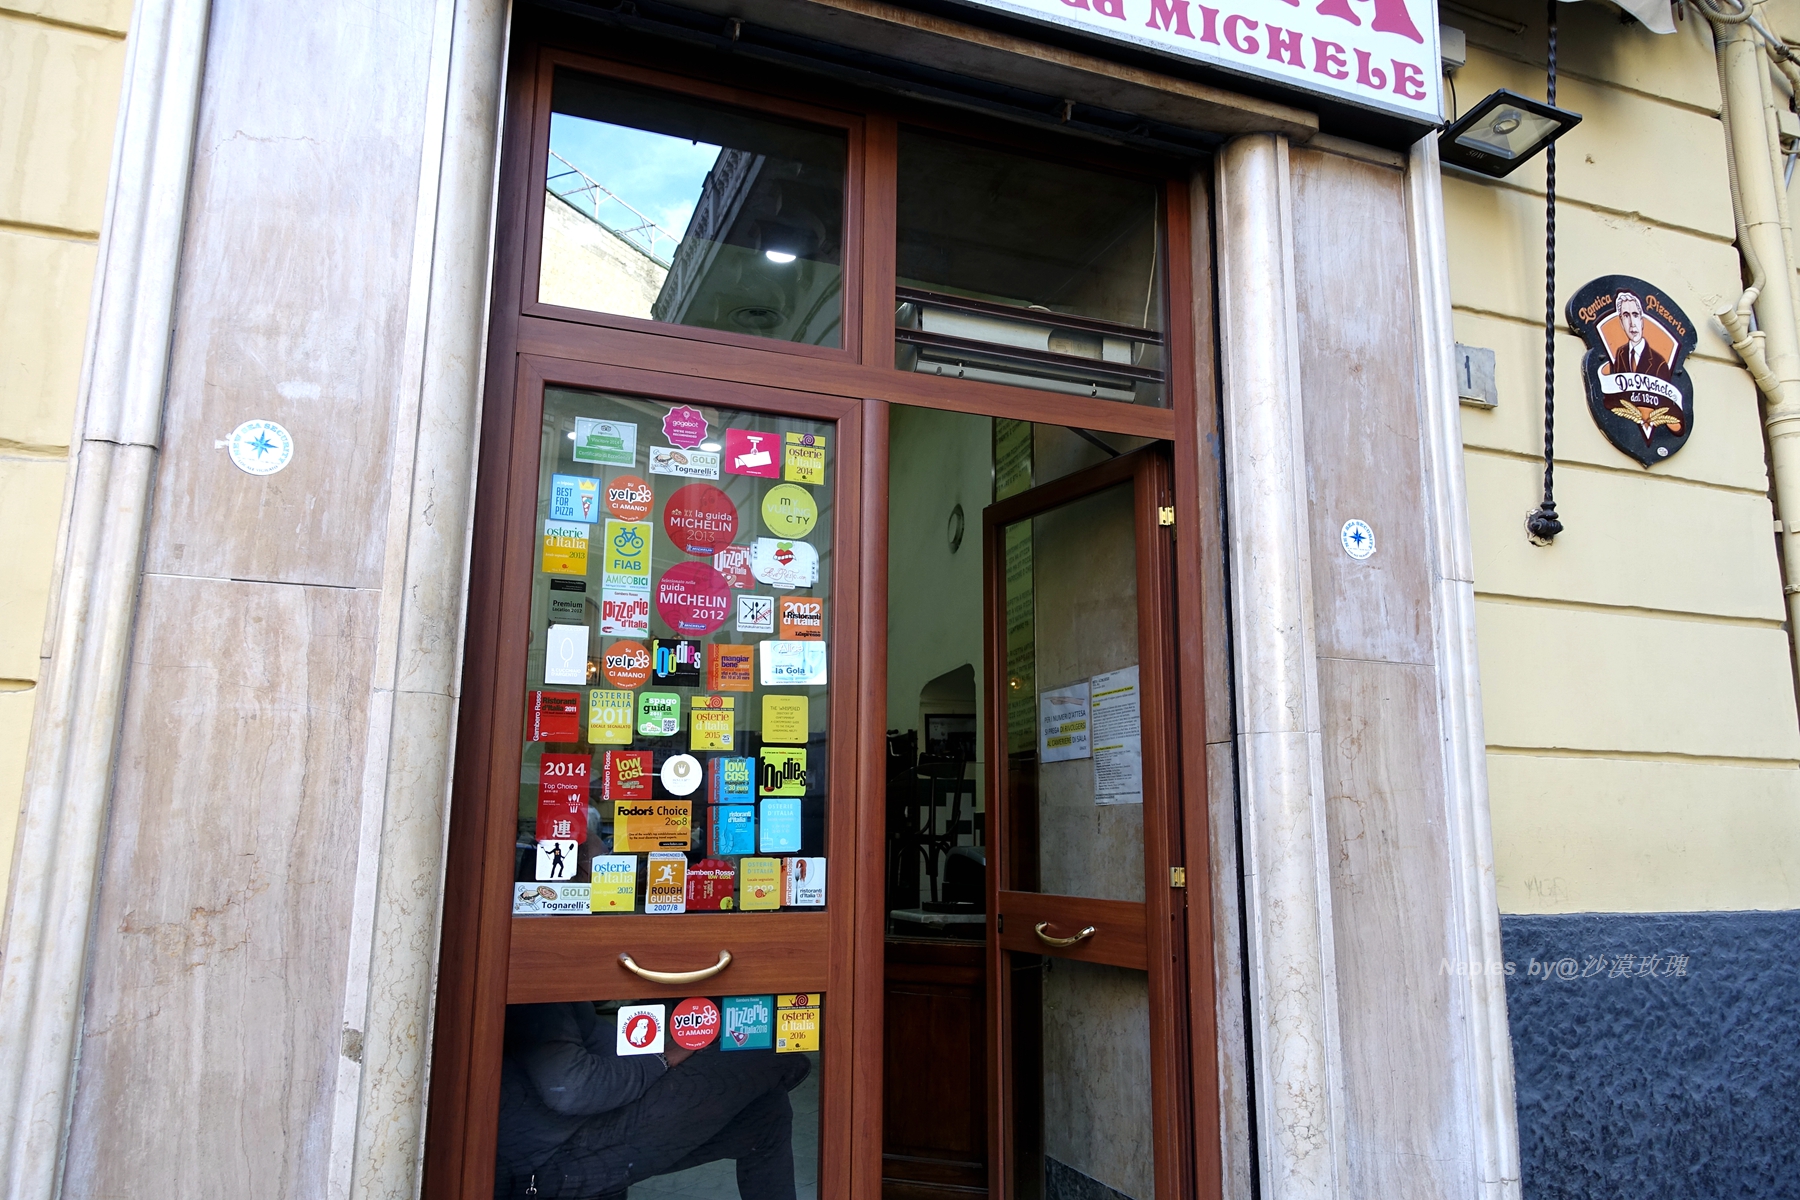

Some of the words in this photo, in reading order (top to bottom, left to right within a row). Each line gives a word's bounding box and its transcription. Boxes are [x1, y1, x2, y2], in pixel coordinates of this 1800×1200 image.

[1145, 0, 1427, 101] MICHELE
[1646, 294, 1686, 336] Pizzeria
[1615, 374, 1634, 392] Da
[1634, 374, 1673, 398] Michele
[1630, 392, 1641, 402] dal
[1642, 394, 1659, 406] 1870
[264, 422, 290, 464] SECURITY
[789, 448, 822, 459] osterie
[692, 456, 716, 464] GOLD
[788, 458, 822, 469] d'Italia
[674, 465, 717, 476] Tognarelli's
[796, 467, 813, 475] 2014
[556, 487, 573, 497] BEST
[610, 488, 638, 503] yelp
[556, 497, 568, 506] FOR
[555, 506, 573, 516] PIZZA
[620, 504, 647, 512] AMANO!
[766, 504, 810, 518] VUELING
[695, 510, 703, 518] la
[706, 512, 732, 521] guida
[670, 517, 732, 532] MICHELIN
[546, 526, 583, 538] osterie
[686, 530, 715, 542] 2013
[546, 538, 586, 549] d'Italia
[614, 560, 642, 570] FIAB
[606, 575, 648, 586] AMICOBICI
[553, 600, 583, 608] Premium
[660, 592, 727, 608] MICHELIN
[784, 602, 820, 615] 2012
[692, 609, 724, 620] 2012
[621, 620, 647, 629] d'Italia
[783, 617, 820, 626] d'Italia
[607, 655, 635, 669] yelp
[653, 640, 700, 676] foodies
[643, 704, 672, 714] guida
[591, 708, 631, 724] 2011
[696, 712, 729, 721] osterie
[696, 721, 729, 730] d'Italia
[544, 762, 586, 777] 2014
[615, 757, 640, 771] low
[725, 760, 746, 772] low
[619, 766, 644, 780] cost
[724, 770, 749, 781] cost
[618, 806, 653, 816] Fodor's
[657, 806, 688, 815] Choice
[665, 817, 688, 826] 2008
[594, 861, 630, 873] osterie
[594, 872, 633, 884] d'Italia
[562, 888, 590, 896] GOLD
[650, 895, 683, 903] GUIDES
[542, 901, 590, 910] Tognarelli's
[675, 1012, 703, 1028] yelp
[782, 1010, 815, 1020] osterie
[781, 1020, 815, 1031] d'Italia
